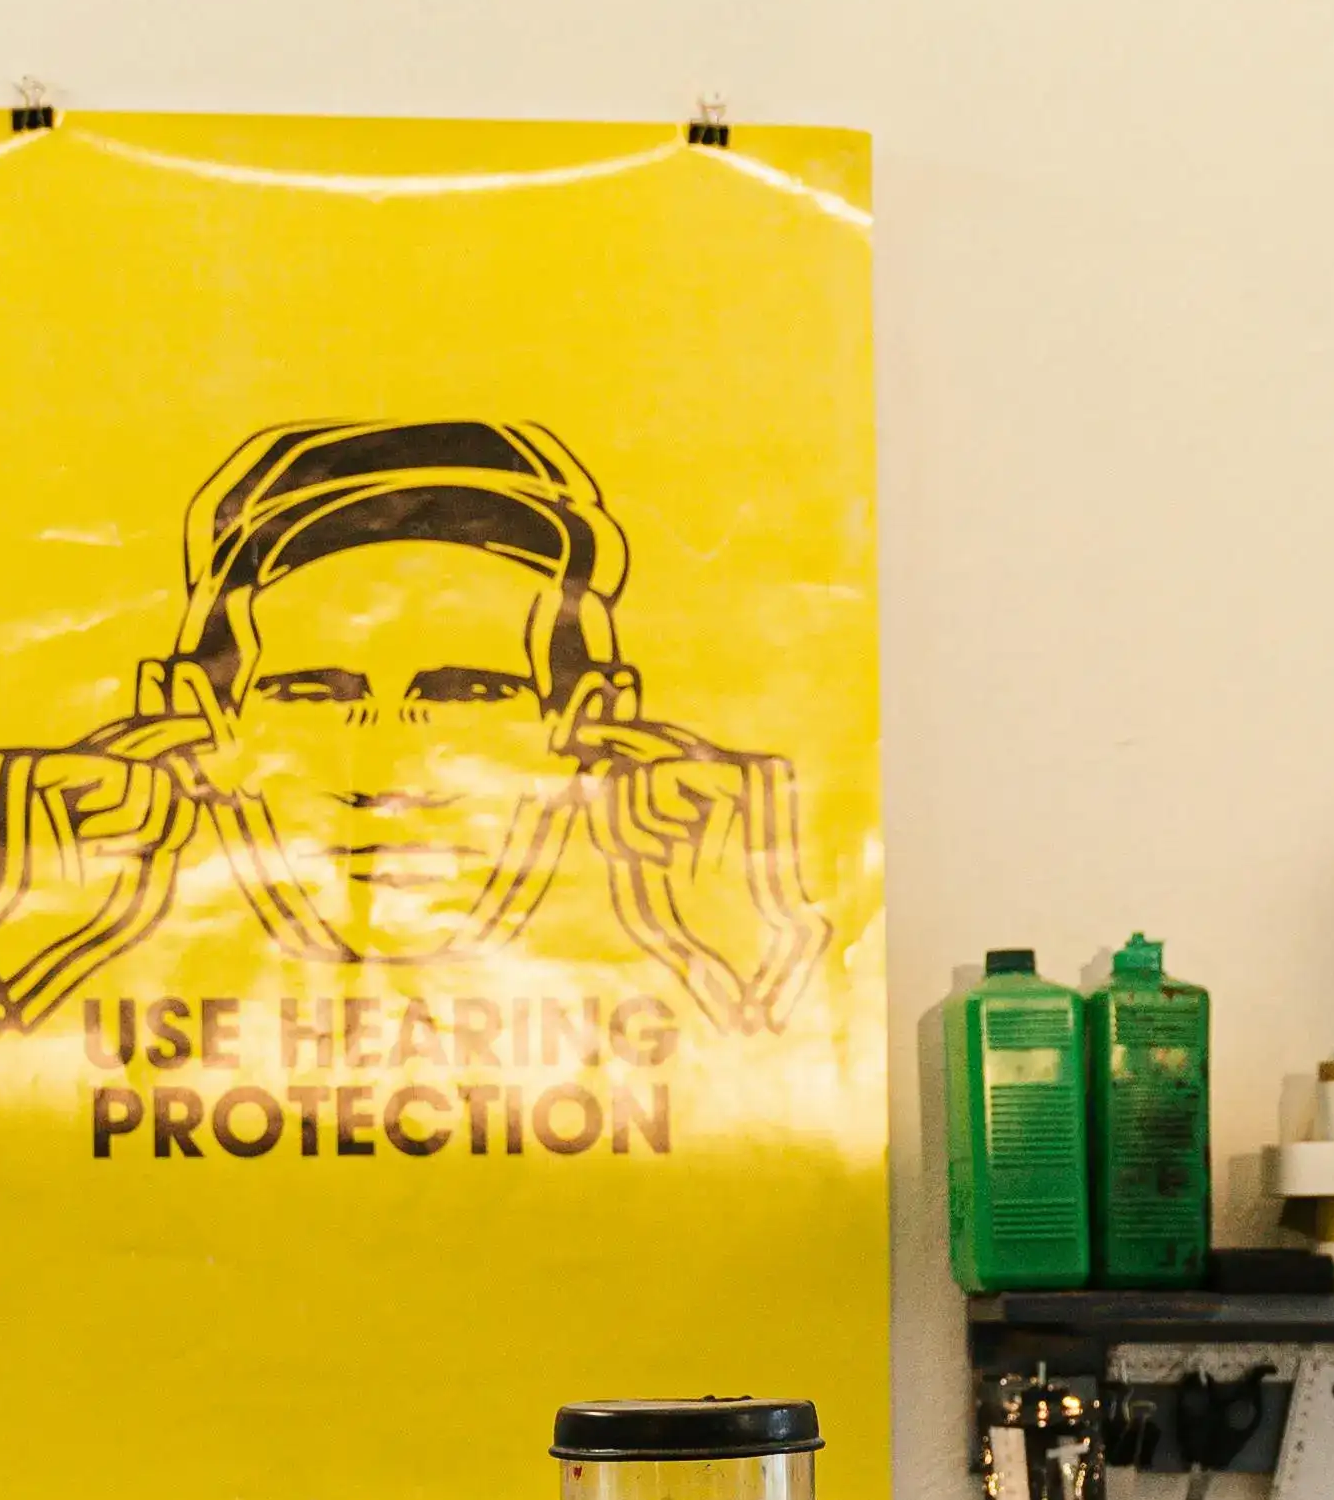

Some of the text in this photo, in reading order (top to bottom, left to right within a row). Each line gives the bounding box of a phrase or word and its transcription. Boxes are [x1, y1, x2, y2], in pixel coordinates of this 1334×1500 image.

[83, 994, 679, 1069] USE HEARING
[92, 1082, 672, 1159] PROTECTION
